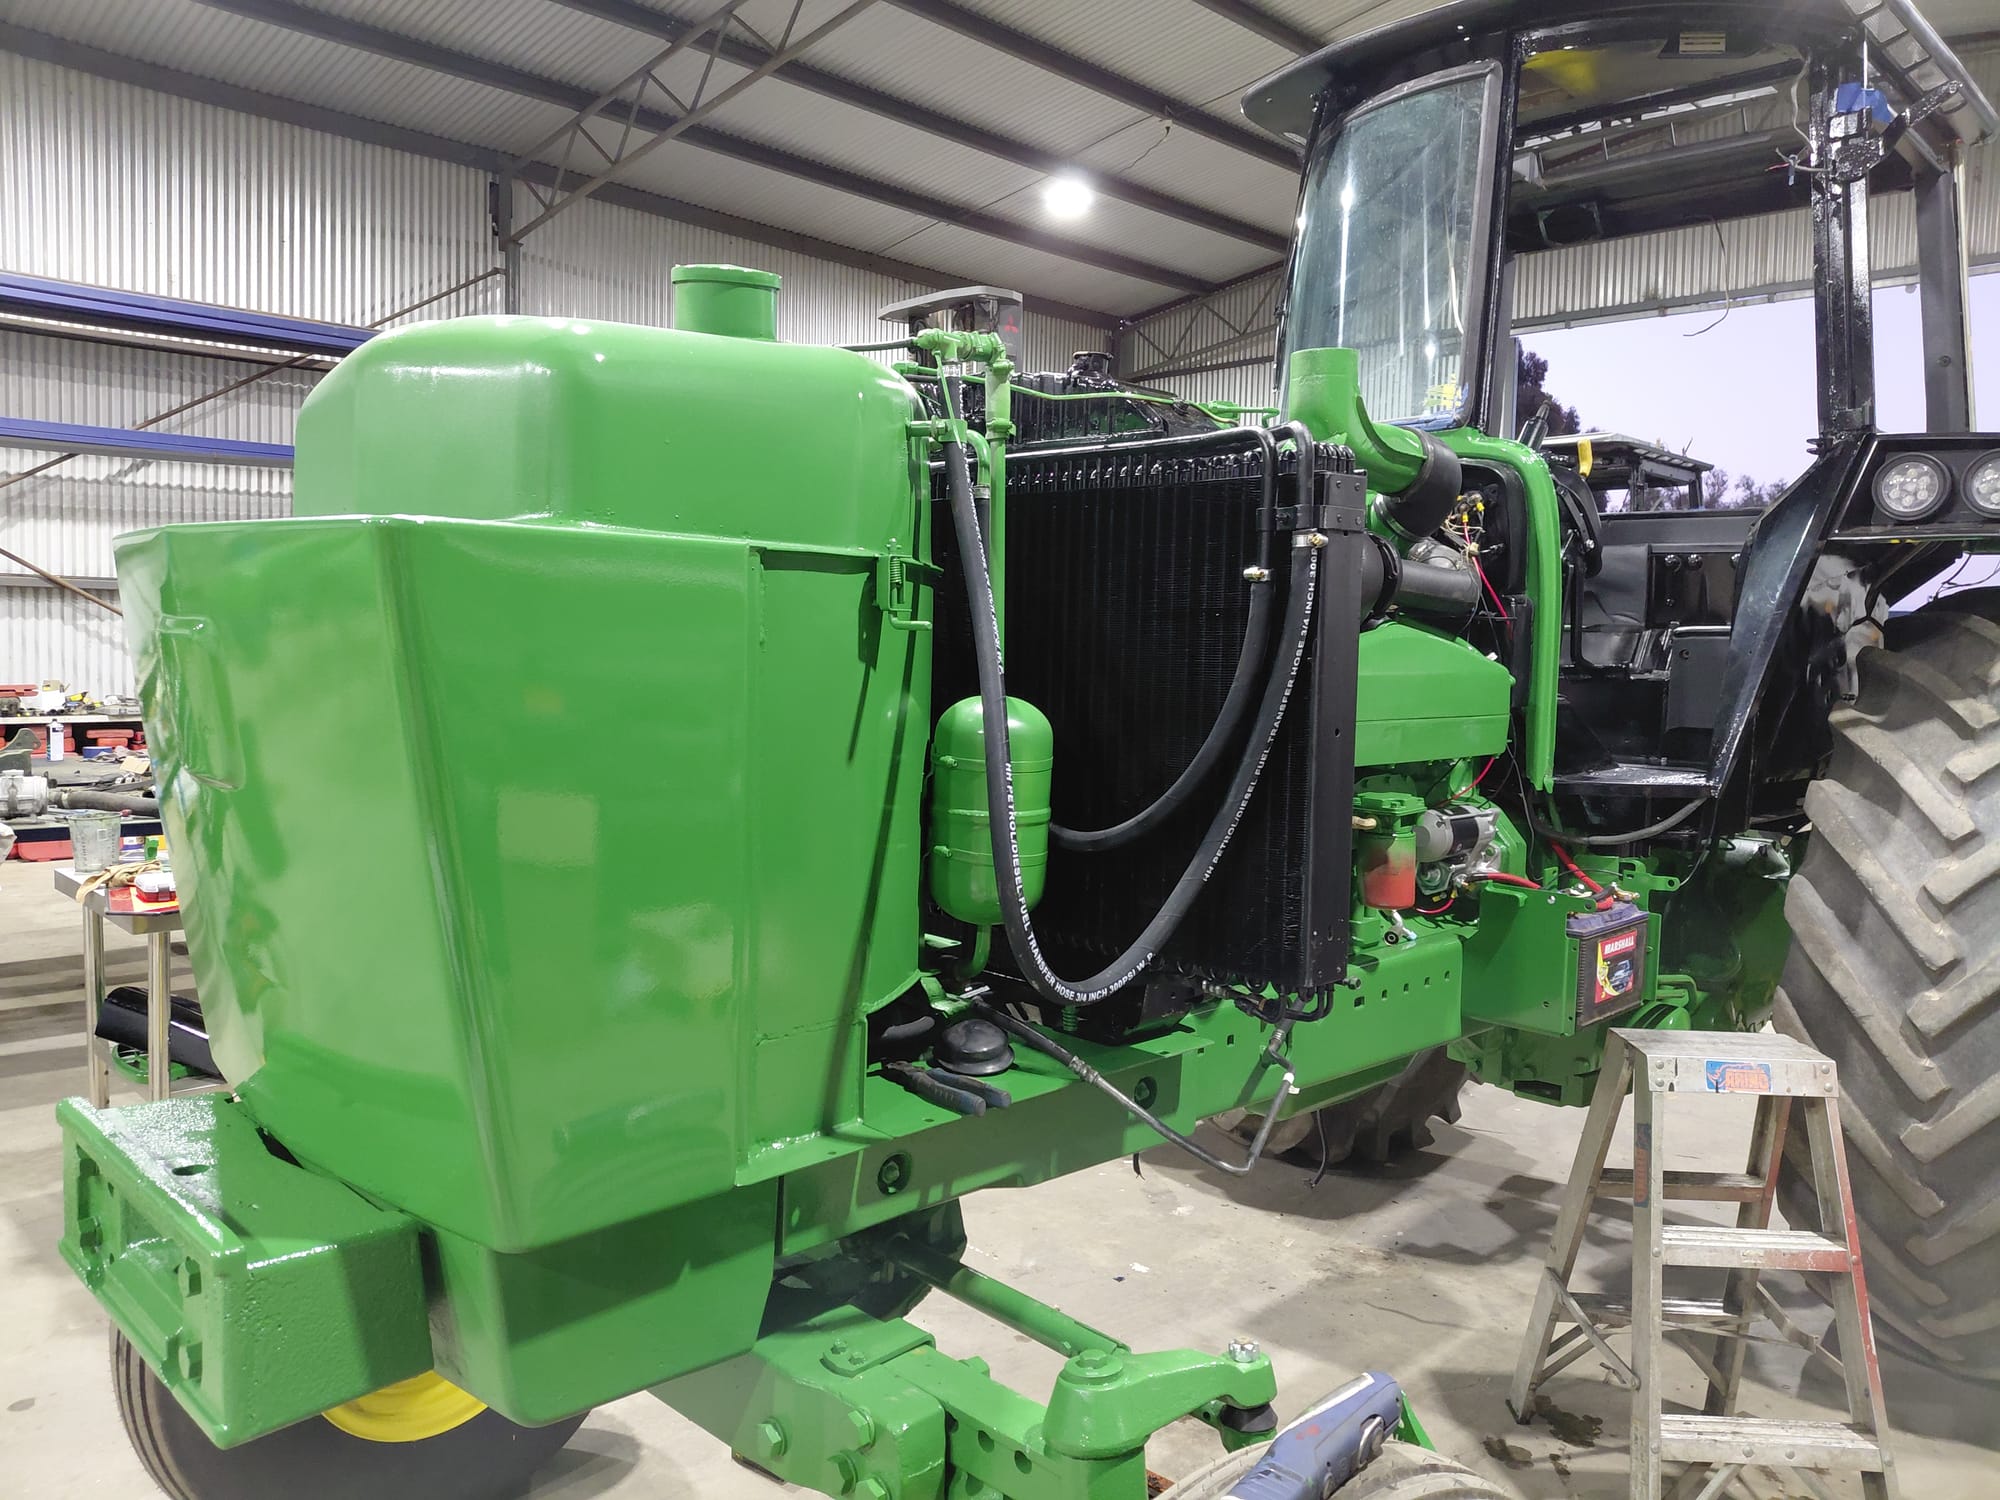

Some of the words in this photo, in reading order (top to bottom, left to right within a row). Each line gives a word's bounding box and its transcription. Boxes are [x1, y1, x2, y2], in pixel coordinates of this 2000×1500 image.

[1304, 582, 1315, 614] INCH
[1300, 618, 1310, 637] 3/4
[1290, 640, 1304, 676] HOSE
[1266, 679, 1295, 744] TRANSFER
[1254, 746, 1272, 776] FUEL
[1212, 779, 1258, 864] PETROL/DIESEL
[1006, 784, 1024, 895] PETROL/DIESEL
[1018, 896, 1031, 932] FUEL
[1027, 931, 1057, 987] TRANSFER
[1054, 981, 1075, 1001] HOSE
[1075, 992, 1087, 1002] 3/4
[1088, 987, 1108, 1002] INCH
[1109, 968, 1136, 994] 300PSI
[1604, 935, 1634, 955] MARSHALL
